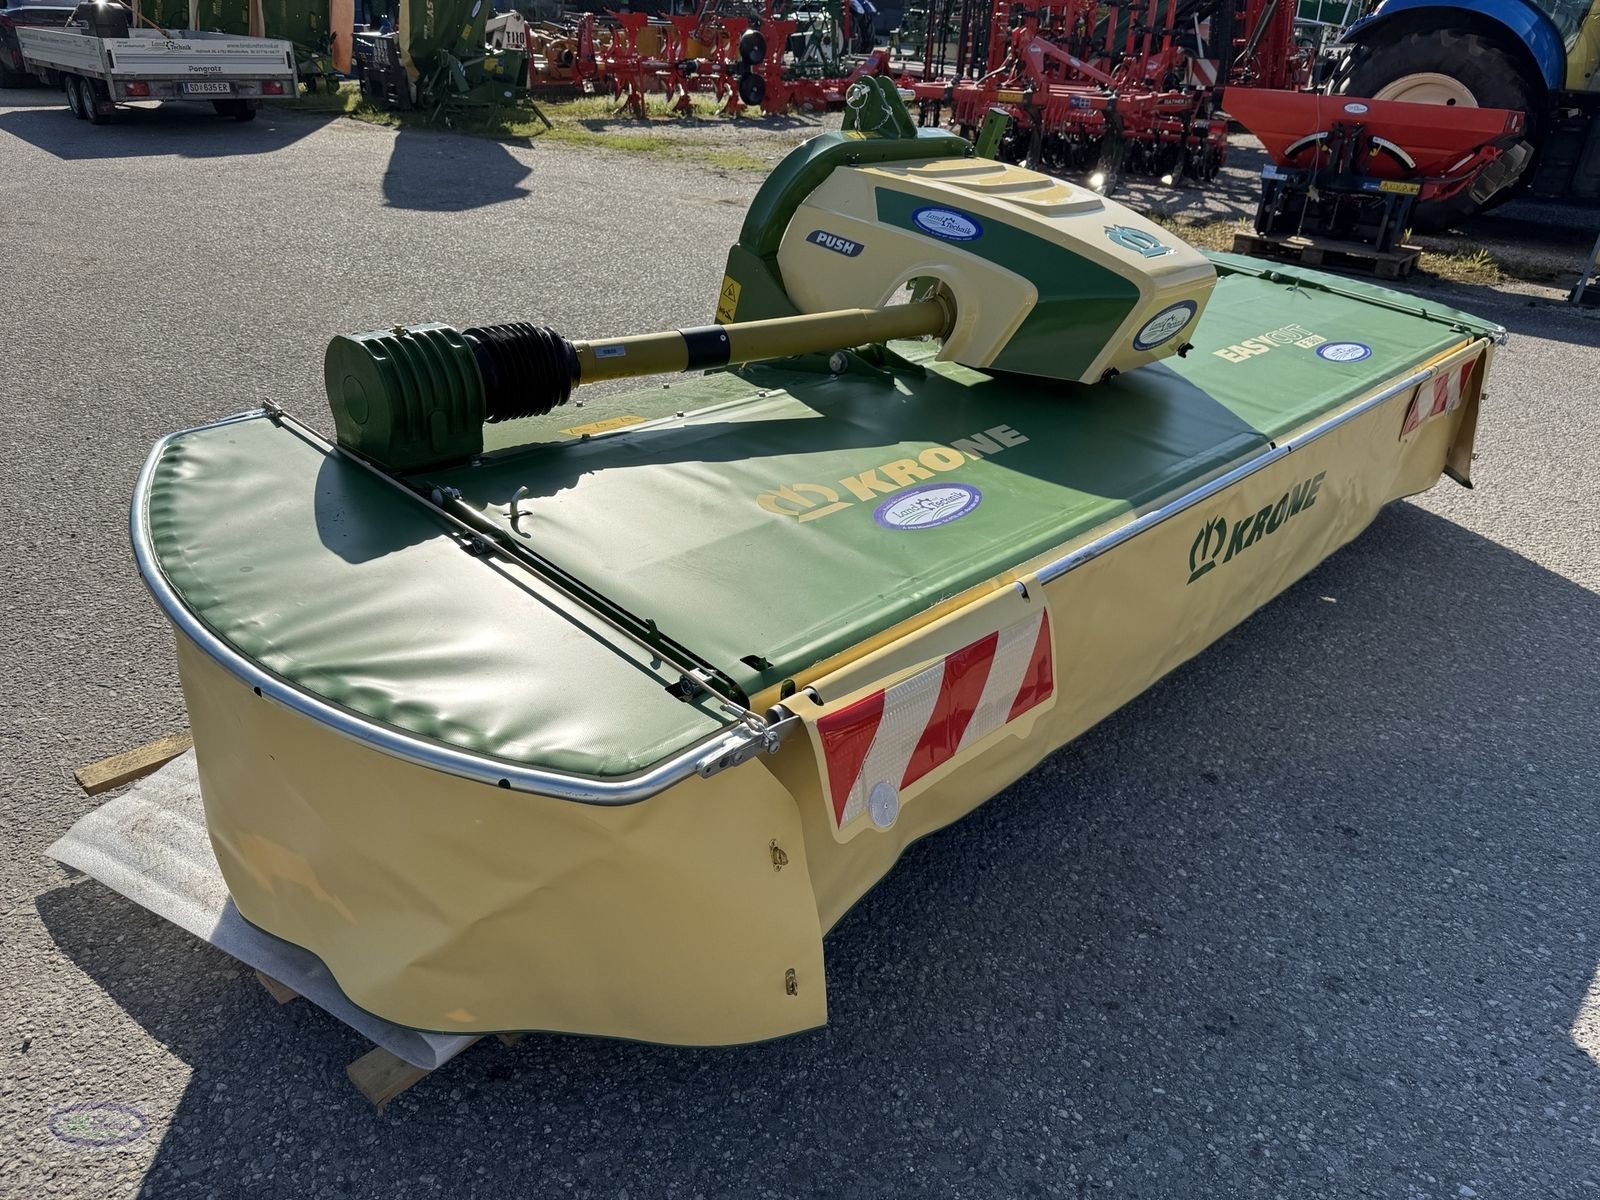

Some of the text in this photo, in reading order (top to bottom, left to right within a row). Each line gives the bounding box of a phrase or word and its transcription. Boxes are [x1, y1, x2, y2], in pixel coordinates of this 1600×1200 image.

[188, 65, 222, 74] Pongratz
[190, 83, 200, 92] SD
[219, 83, 228, 91] ER
[926, 212, 945, 222] Land
[946, 222, 972, 235] Technik
[815, 231, 855, 255] PUSH
[1212, 323, 1313, 363] EASYCUT
[838, 424, 1030, 502] KRONE
[892, 503, 920, 518] Land
[929, 491, 967, 510] Technik
[1222, 470, 1327, 564] KRONE
